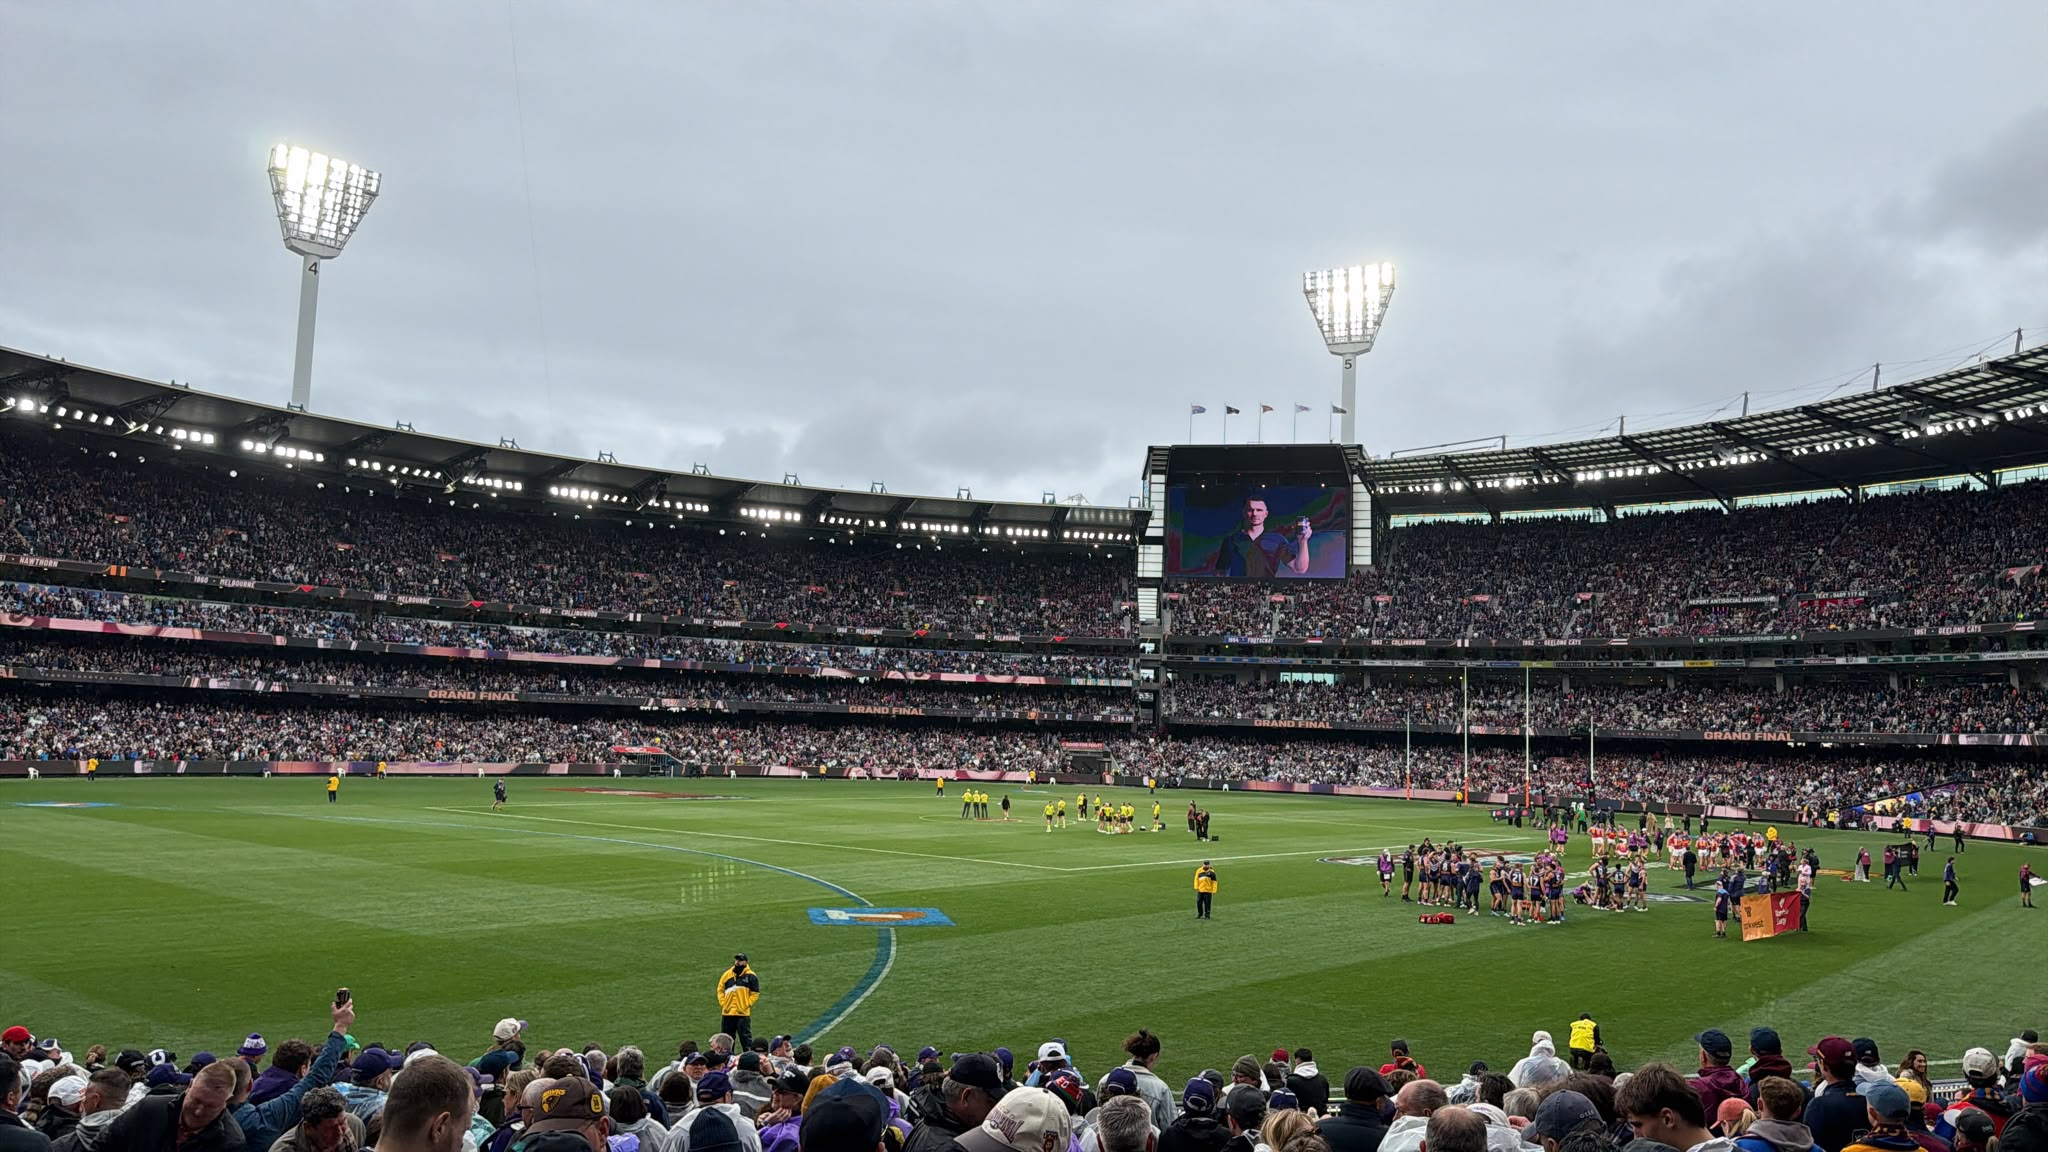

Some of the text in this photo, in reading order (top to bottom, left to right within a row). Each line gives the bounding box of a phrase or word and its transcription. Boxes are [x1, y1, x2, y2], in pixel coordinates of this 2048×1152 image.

[308, 262, 318, 275] 4
[1344, 359, 1352, 369] 5
[19, 556, 59, 567] HAWTHORN
[220, 579, 256, 589] MELBOURNE
[397, 595, 430, 605] MELBOURNE
[561, 609, 598, 618] COLLINGWOOD
[713, 620, 741, 628] MELBOURNE
[856, 628, 883, 636] MELBOURNE
[1914, 624, 1981, 636] 1951 GEELONG CATS
[993, 634, 1020, 642] MELBOURNE
[1391, 639, 1426, 647] COLLINGWOOD
[1544, 639, 1567, 647] GEELONG
[1568, 638, 1582, 646] CATS
[428, 689, 519, 702] GRAND FINAL
[849, 704, 926, 716] GRAND FINAL
[1254, 718, 1333, 730] GRAND FINAL
[1704, 731, 1751, 741] GRAND
[1755, 731, 1794, 742] FINAL
[1512, 871, 1522, 883] 21
[1529, 875, 1539, 886] 17
